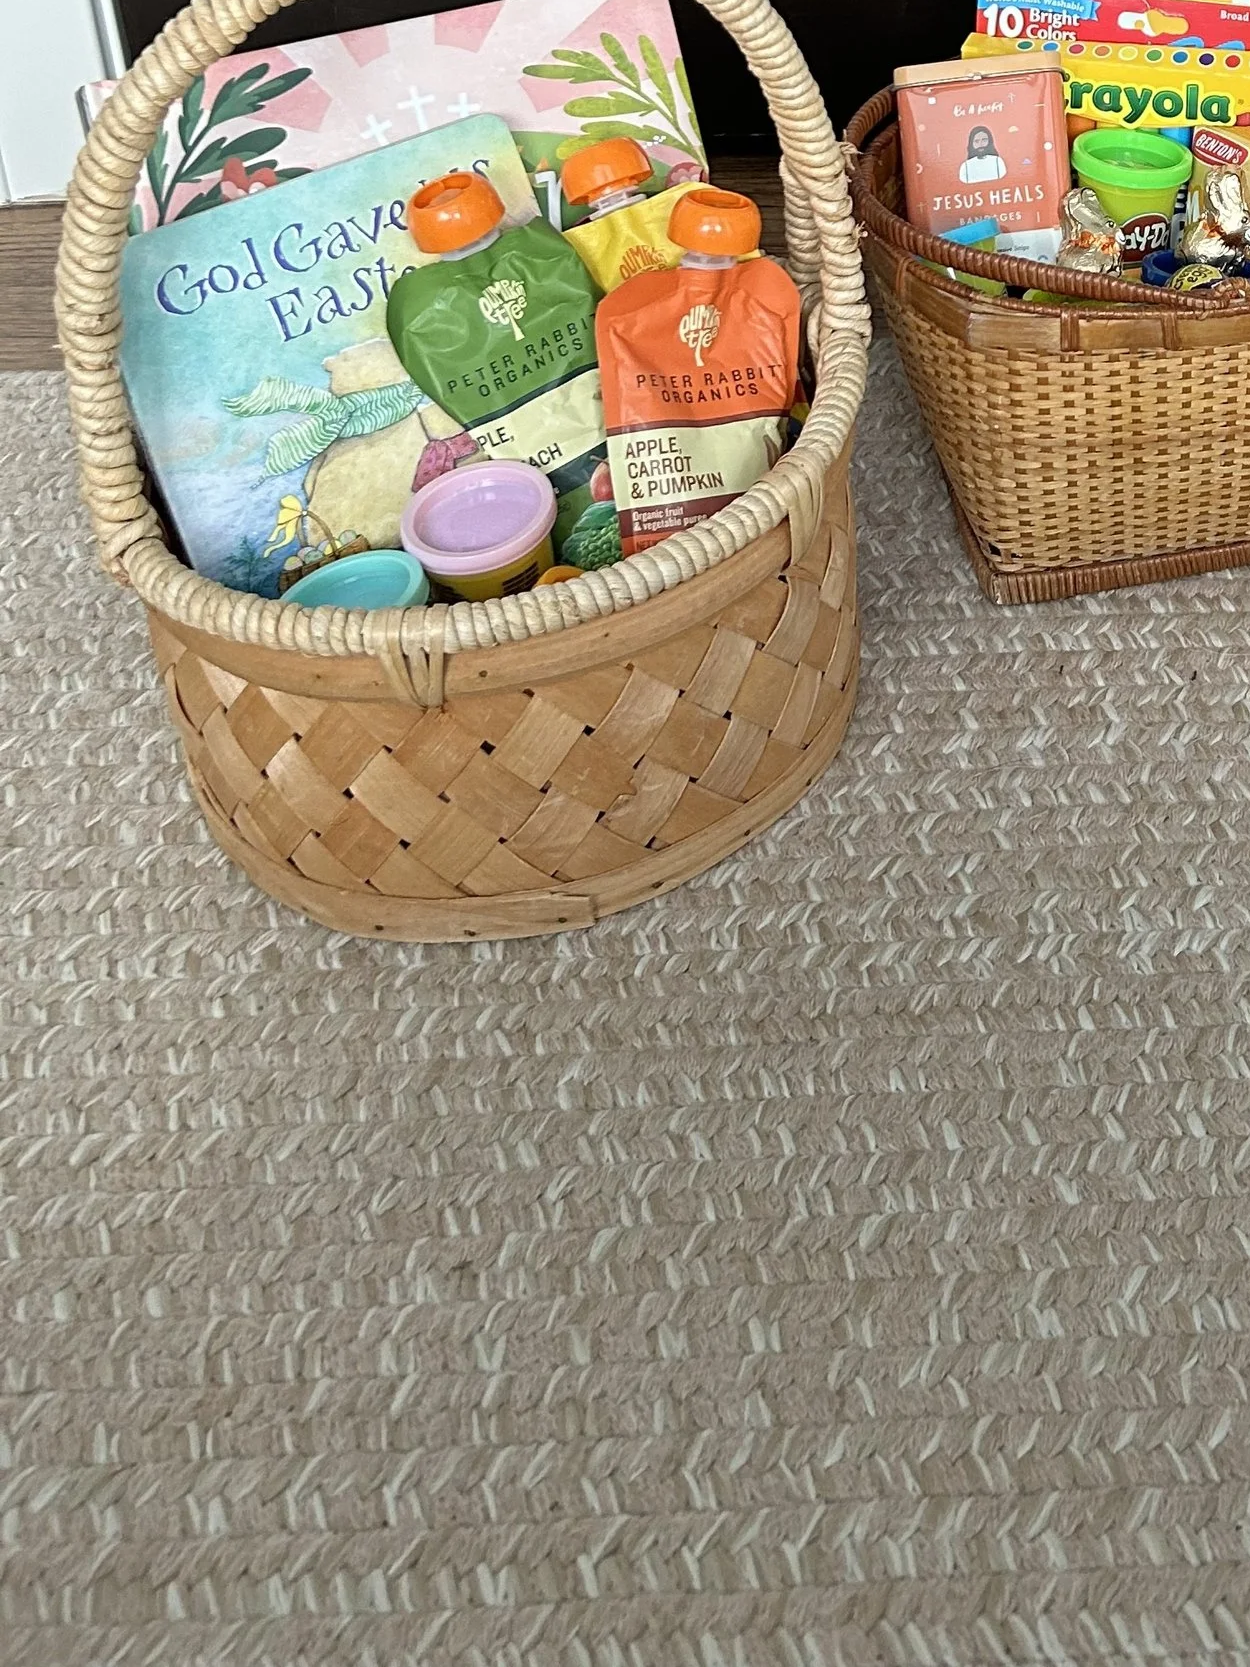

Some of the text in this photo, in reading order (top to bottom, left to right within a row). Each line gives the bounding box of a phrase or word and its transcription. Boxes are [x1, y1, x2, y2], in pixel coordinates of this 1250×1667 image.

[982, 3, 1024, 38] 10
[1028, 7, 1081, 29] Bright
[1219, 9, 1250, 23] Broad
[1025, 24, 1078, 42] Colors
[1064, 72, 1231, 124] rayola
[1195, 133, 1242, 164] BENTON'S
[933, 184, 1045, 211] JESUS HEALS
[156, 237, 270, 316] God
[274, 199, 409, 274] Gave
[265, 255, 416, 343] East
[448, 354, 515, 394] PETER
[478, 338, 584, 398] ORGANICS
[636, 364, 779, 388] PETER RABBIT
[661, 383, 759, 405] ORGANICS
[478, 426, 515, 453] PLE,
[625, 436, 683, 460] APPLE,
[627, 456, 692, 479] CARROT
[631, 472, 725, 499] & PUMPKIN
[632, 506, 684, 523] Organic fruit
[643, 517, 682, 531] vegetable
